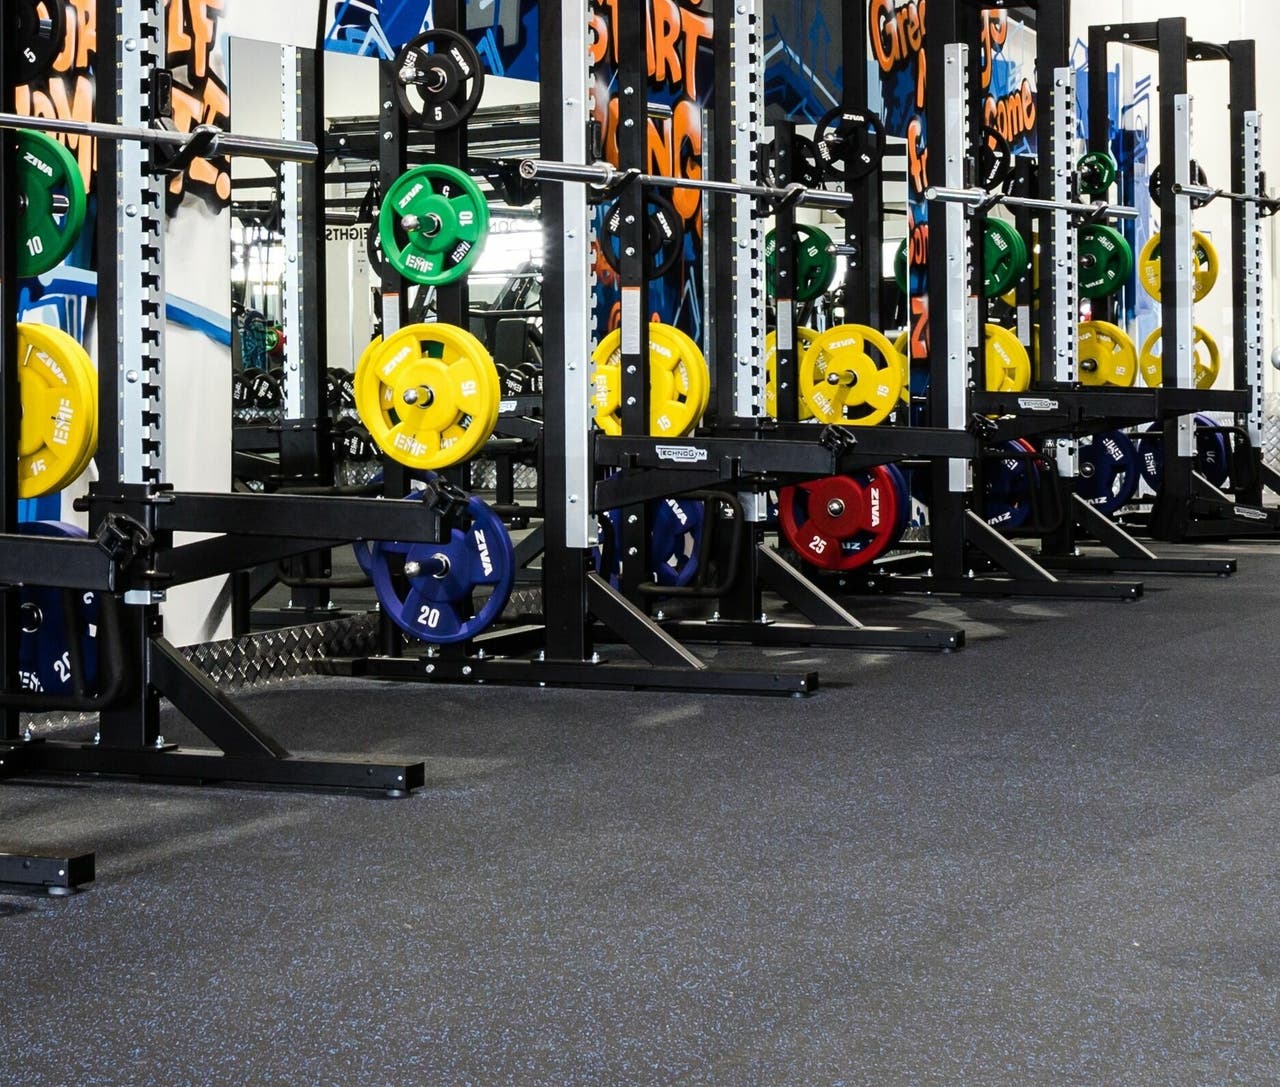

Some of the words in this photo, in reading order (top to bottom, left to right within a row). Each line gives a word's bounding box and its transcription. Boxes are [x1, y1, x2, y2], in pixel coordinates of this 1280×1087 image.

[23, 47, 37, 63] 5
[450, 47, 470, 75] ZIVA
[434, 106, 443, 121] 5
[23, 151, 54, 178] ZIVA
[861, 153, 870, 164] 5
[398, 183, 424, 209] ZIVA
[458, 211, 474, 227] 10
[25, 235, 44, 257] 10
[871, 487, 880, 527] ZIVA
[474, 529, 493, 577] ZIVA
[808, 535, 828, 554] 25
[417, 605, 440, 629] 20
